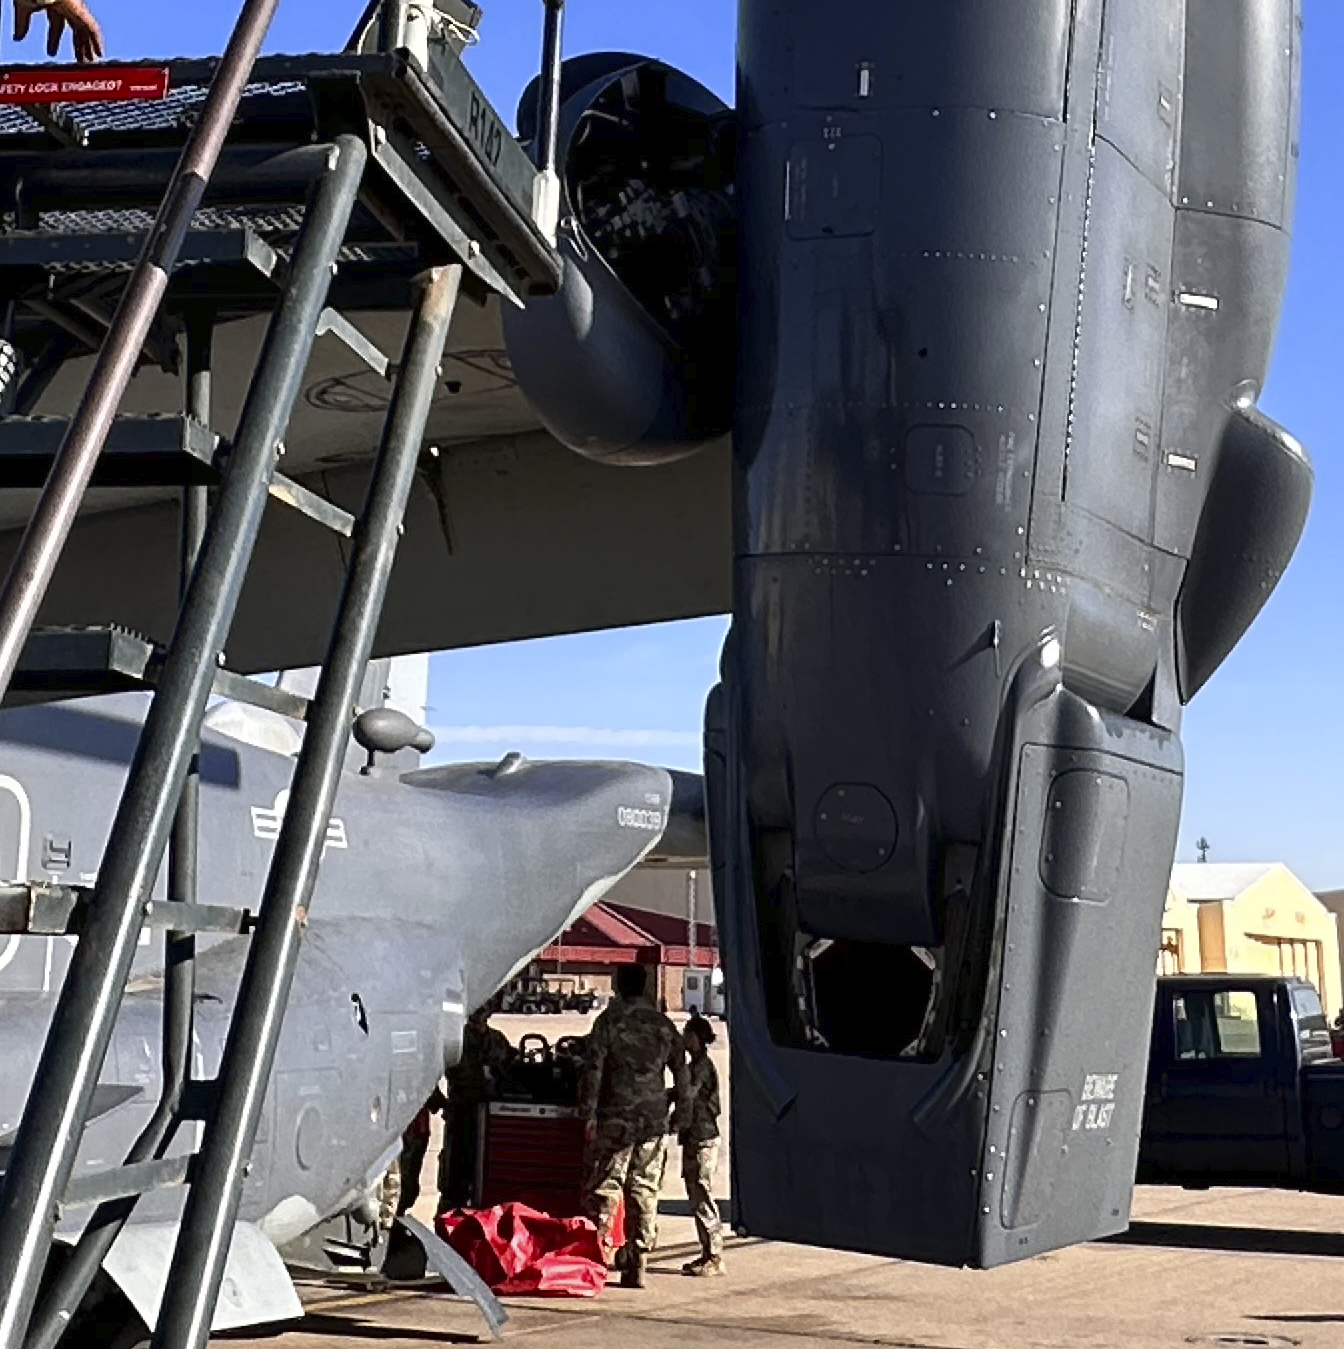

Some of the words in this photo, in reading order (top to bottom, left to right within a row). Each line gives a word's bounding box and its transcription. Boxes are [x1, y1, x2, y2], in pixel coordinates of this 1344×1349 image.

[28, 81, 58, 93] LOCK
[61, 79, 122, 93] ENGAGED?
[1081, 1074, 1118, 1100] BEWARE
[1072, 1103, 1088, 1130] OF
[1085, 1102, 1116, 1129] BLAST
